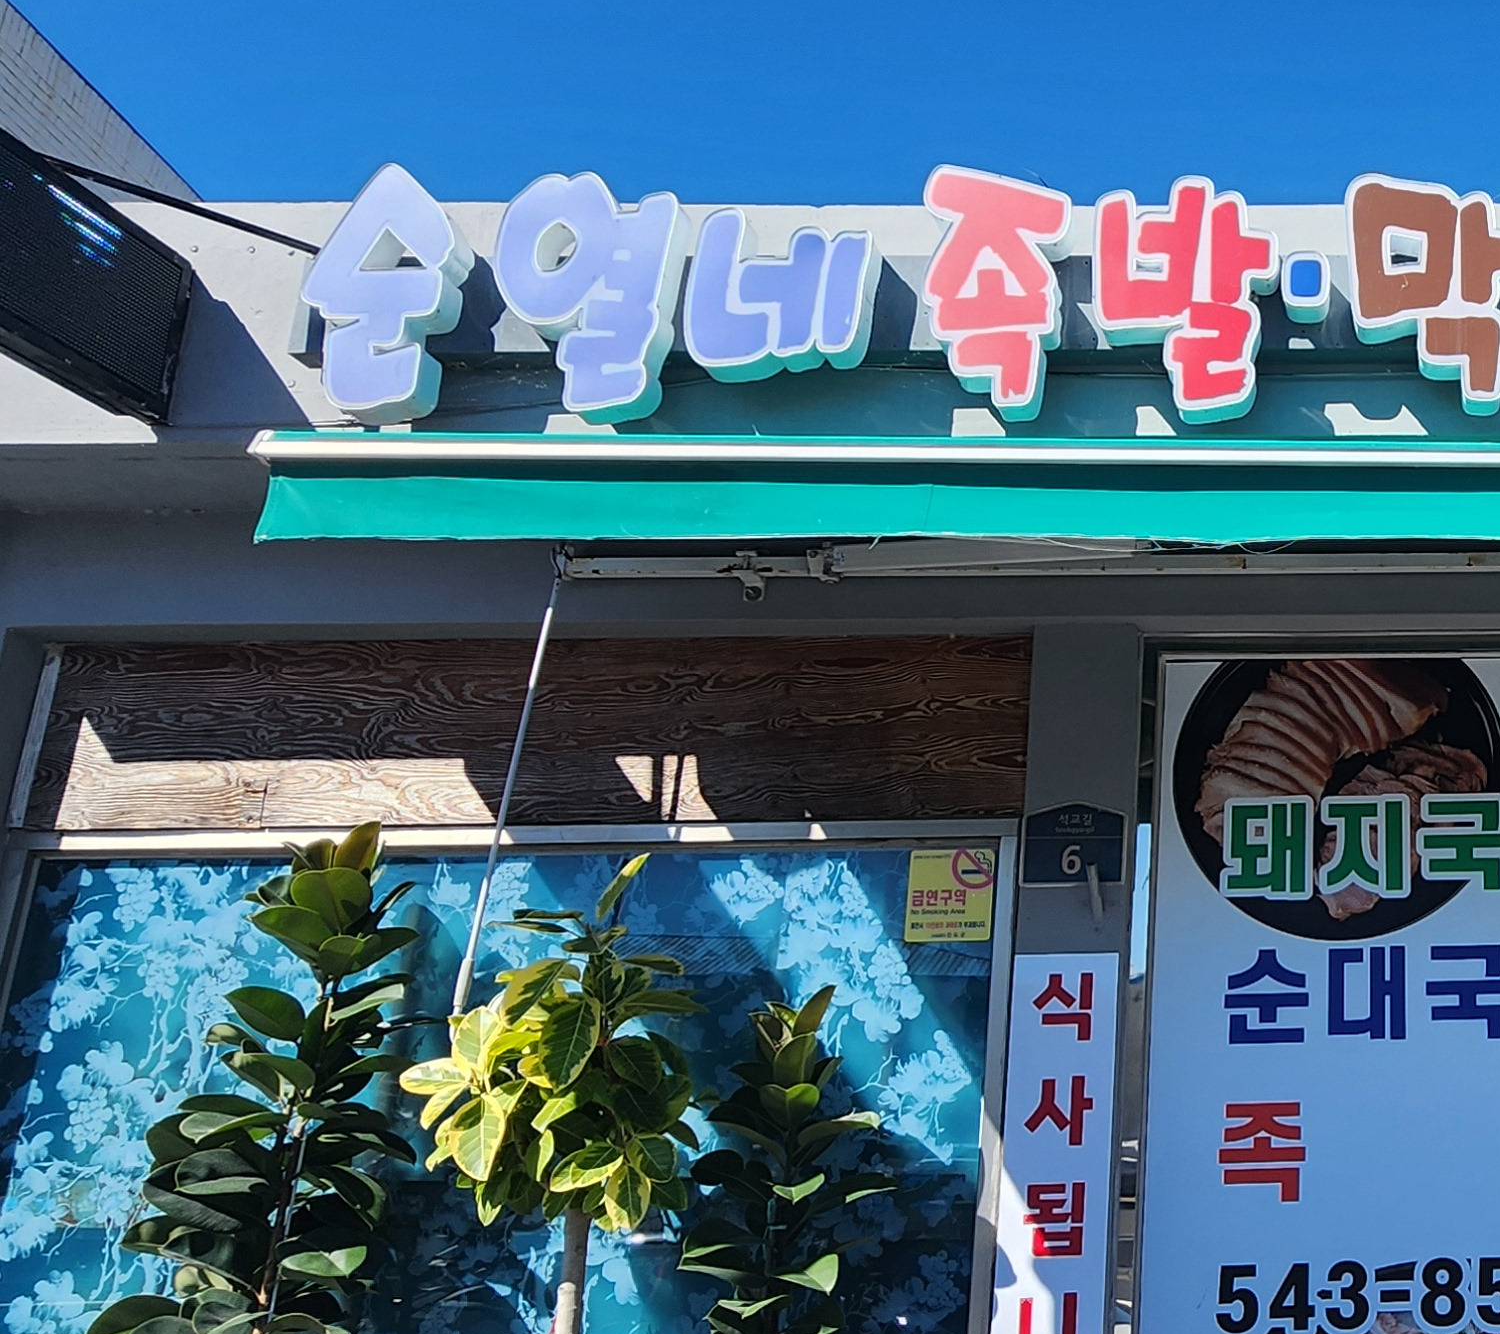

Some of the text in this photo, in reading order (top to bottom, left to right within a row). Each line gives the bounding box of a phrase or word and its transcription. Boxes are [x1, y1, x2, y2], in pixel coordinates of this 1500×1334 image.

[303, 163, 880, 422] 순열네
[1058, 813, 1093, 827] 석교길
[1061, 844, 1082, 875] 6
[912, 889, 967, 907] 금연구역
[921, 908, 949, 916] Smoking
